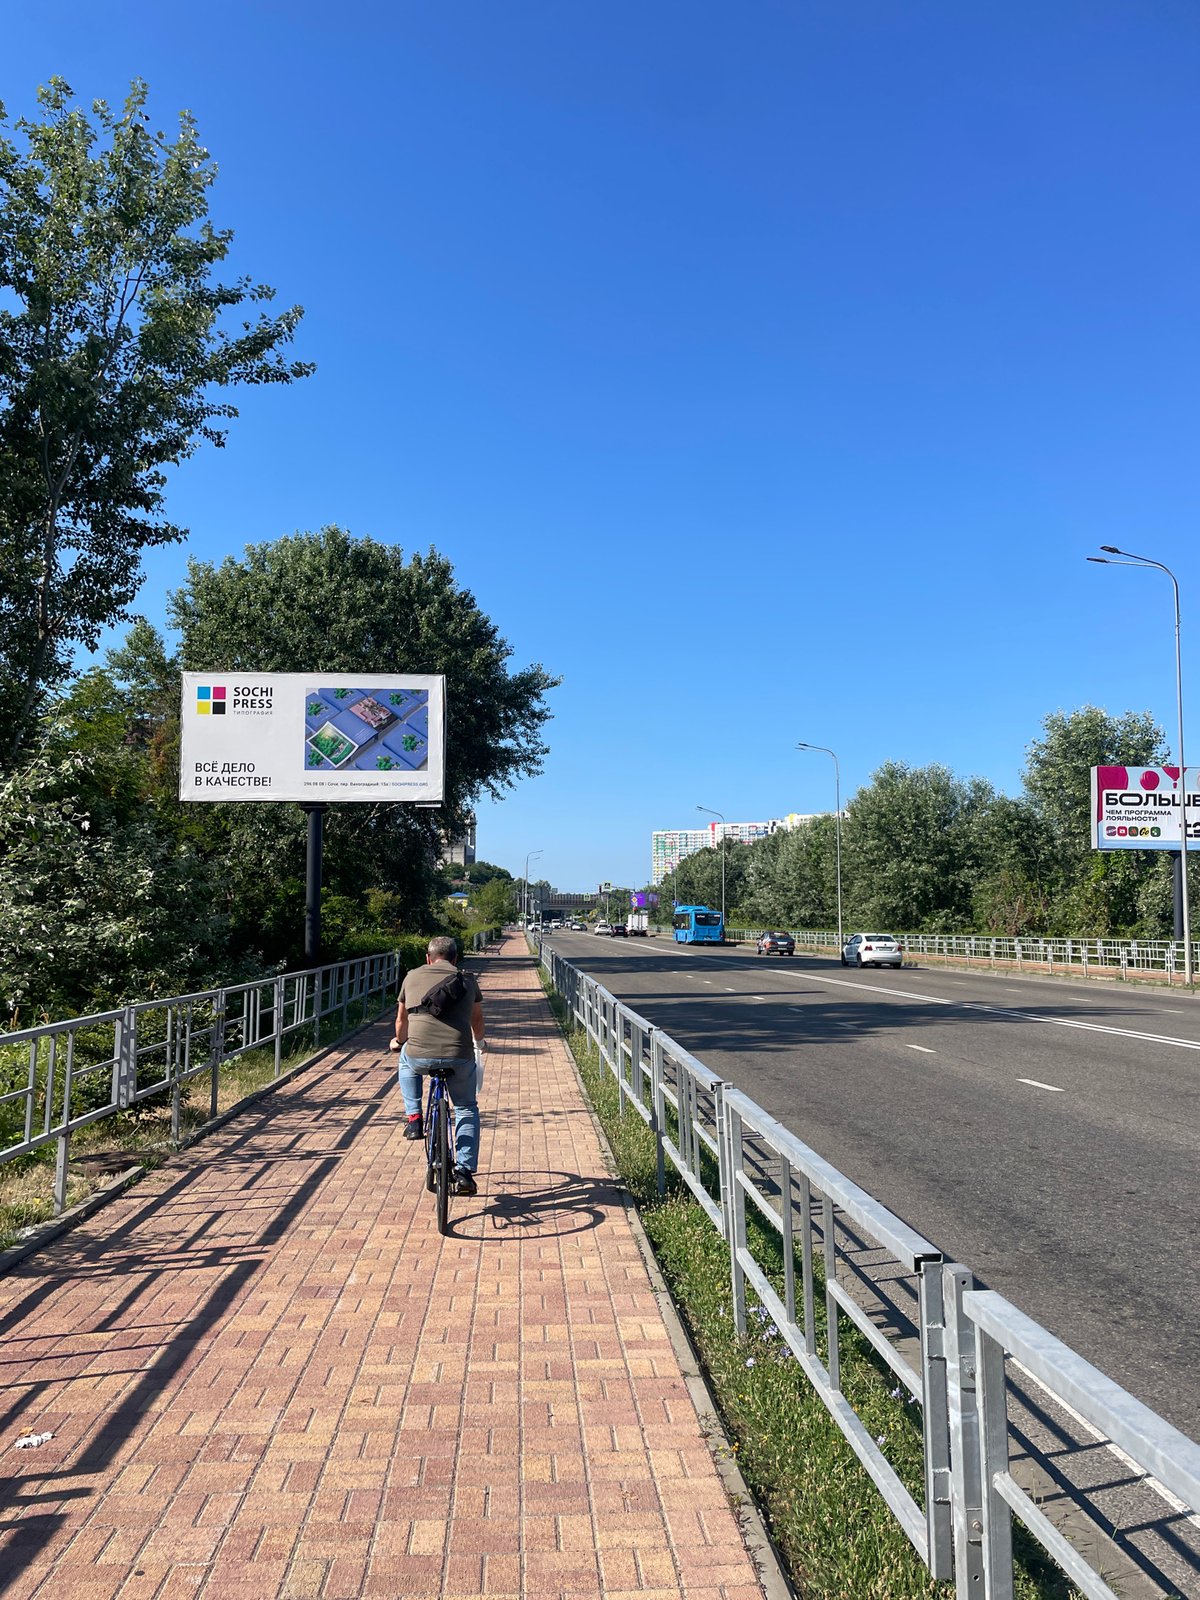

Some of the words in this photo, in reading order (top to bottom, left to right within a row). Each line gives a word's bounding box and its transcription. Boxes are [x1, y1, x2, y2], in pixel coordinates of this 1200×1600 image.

[233, 686, 273, 697] SOCHI
[233, 698, 273, 709] PRESS
[195, 761, 219, 773] ВСЁ
[221, 762, 256, 775] ДЕЛО
[194, 777, 203, 787] В
[206, 777, 272, 787] КАЧЕСТВЕ!
